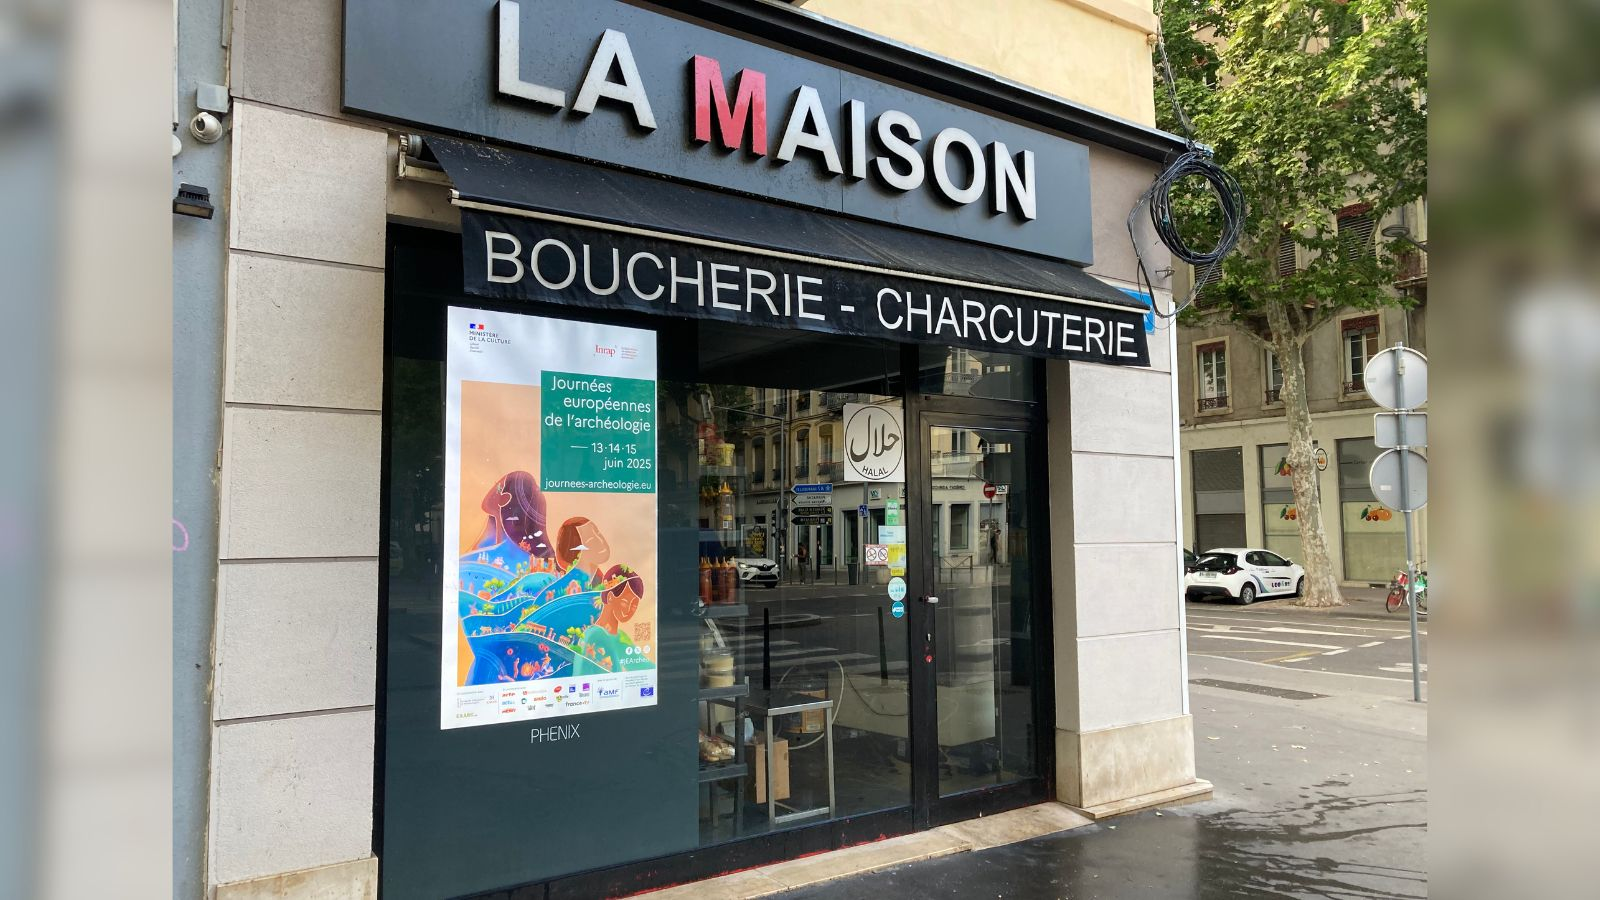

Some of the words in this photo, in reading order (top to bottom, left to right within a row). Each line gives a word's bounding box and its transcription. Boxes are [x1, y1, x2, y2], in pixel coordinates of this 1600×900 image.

[496, 1, 657, 132] LA
[690, 54, 1037, 220] MAISON
[484, 230, 826, 321] BOUCHERIE
[876, 287, 1139, 359] CHARCUTERIE
[487, 337, 512, 345] CULTURE
[595, 344, 616, 358] Inrap
[551, 376, 612, 393] Journées
[563, 397, 651, 413] européennes
[544, 413, 563, 427] de
[567, 414, 651, 434] l'archéologie
[850, 414, 900, 463] حلال
[602, 457, 624, 471] juin
[626, 458, 652, 470] 2025
[861, 465, 889, 477] HALAL
[544, 478, 652, 491] journees-archeologie.eu
[530, 723, 580, 743] PHENIX
